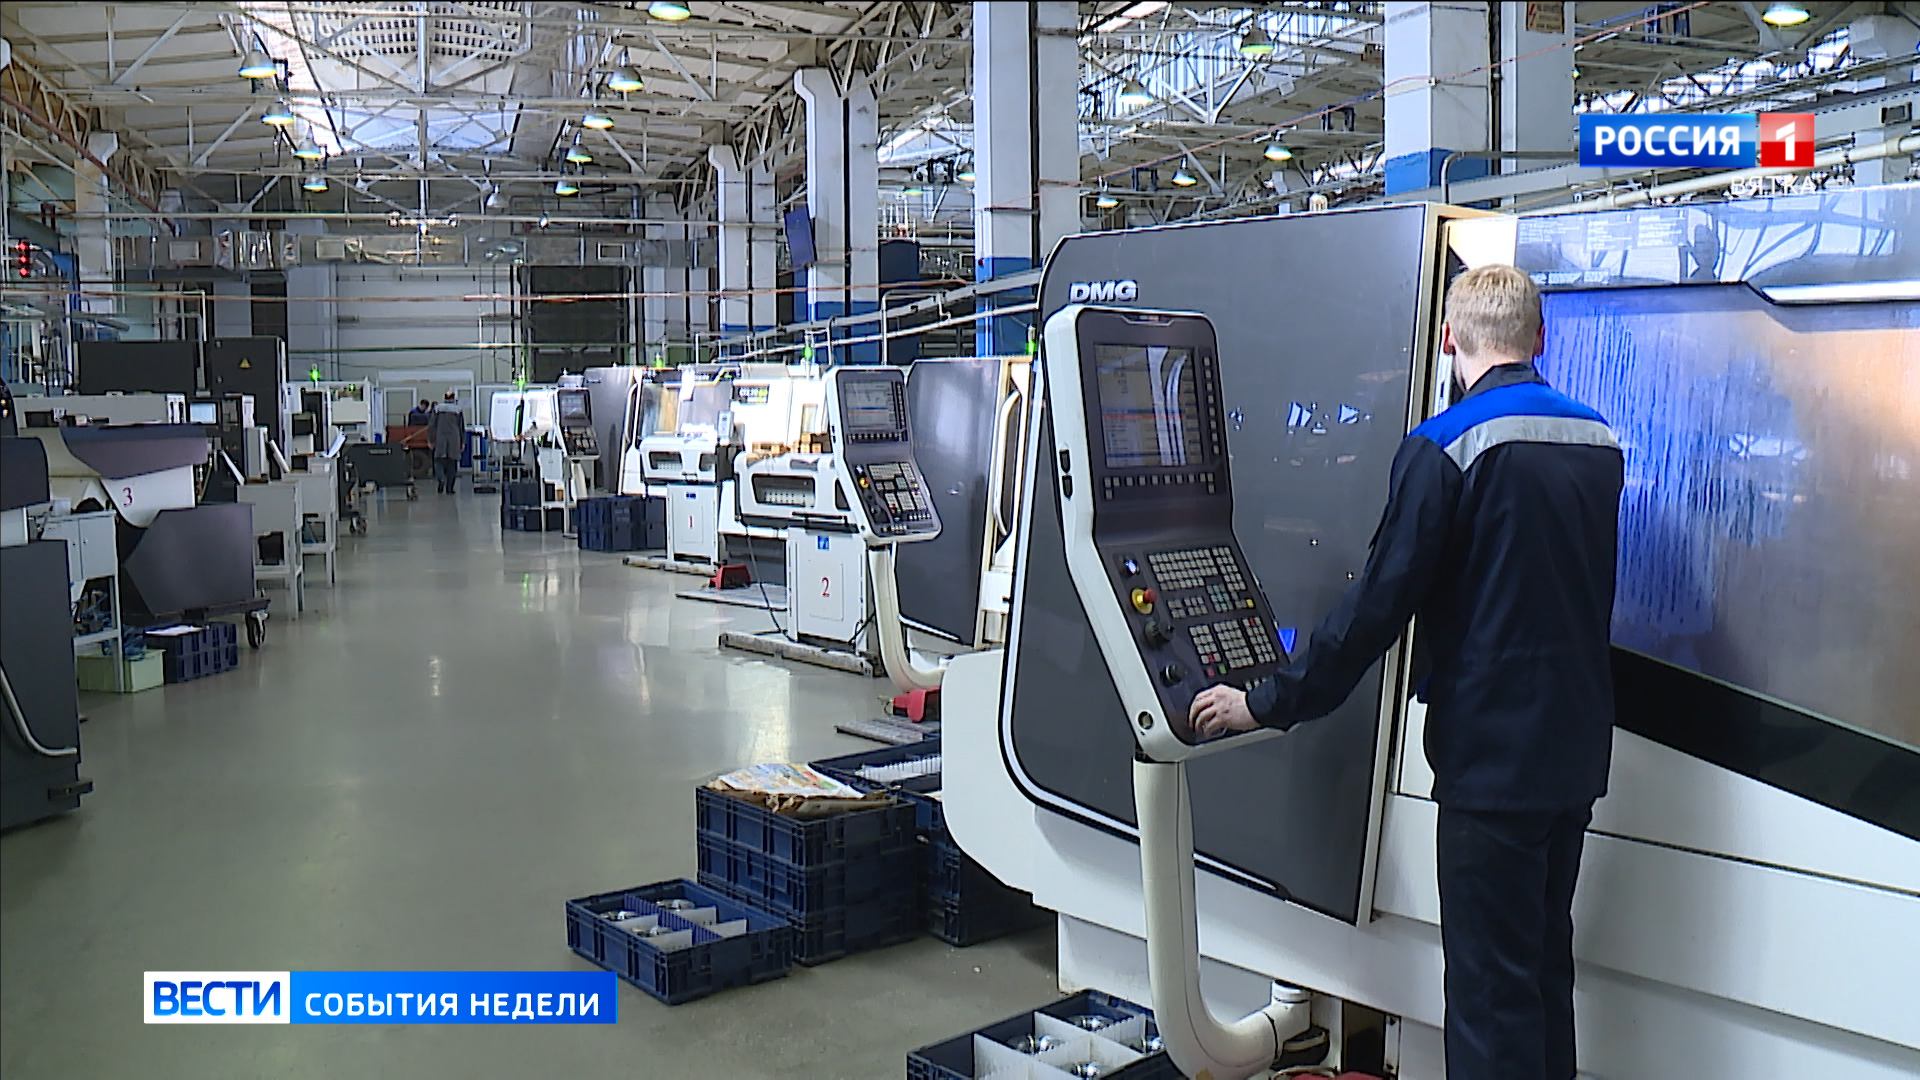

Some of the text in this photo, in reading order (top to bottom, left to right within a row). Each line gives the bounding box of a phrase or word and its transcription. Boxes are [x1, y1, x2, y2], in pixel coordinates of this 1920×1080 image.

[1069, 280, 1138, 302] DMG
[123, 486, 133, 507] 3
[821, 577, 830, 598] 2
